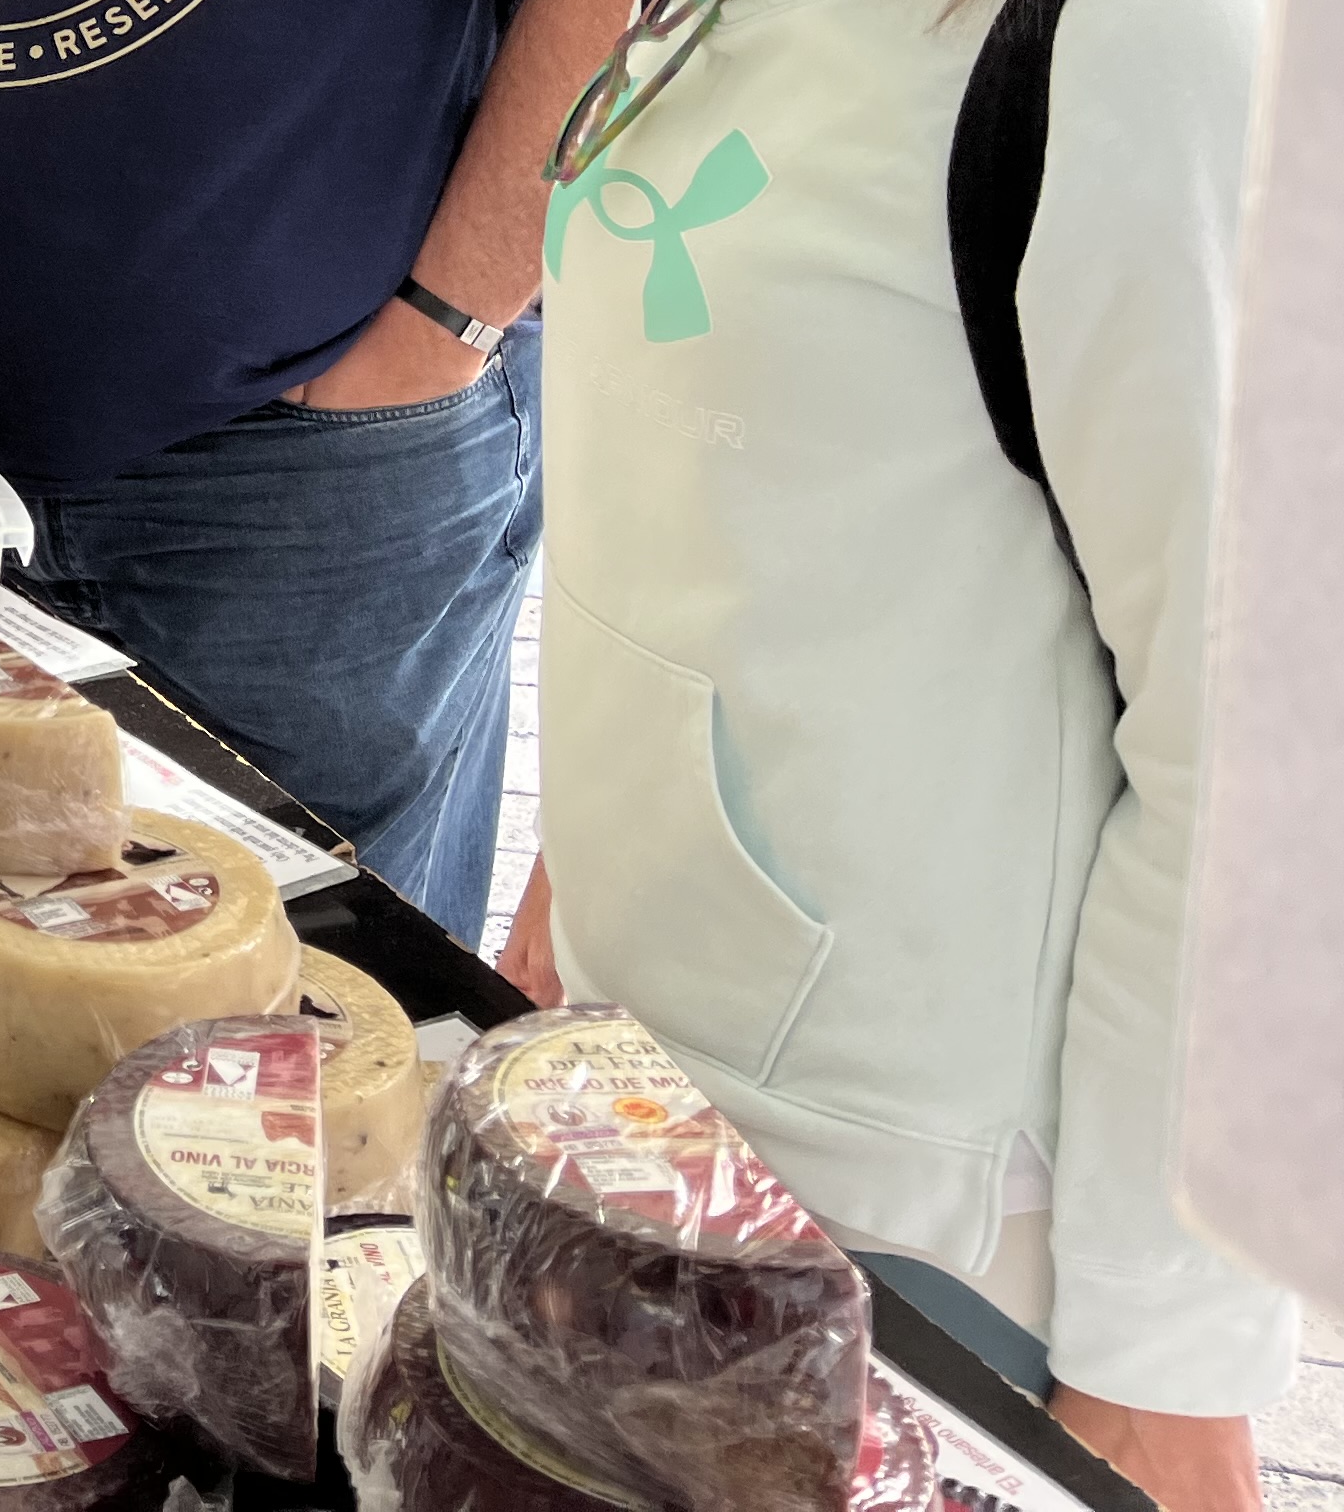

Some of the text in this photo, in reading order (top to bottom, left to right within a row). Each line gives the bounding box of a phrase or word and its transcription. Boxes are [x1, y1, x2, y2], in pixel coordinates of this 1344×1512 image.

[607, 1056, 679, 1070] FRAI
[524, 1078, 605, 1090] QUEO
[608, 1077, 644, 1089] DE
[171, 1149, 315, 1177] RCIA AL VINO
[249, 1194, 313, 1212] ANJA
